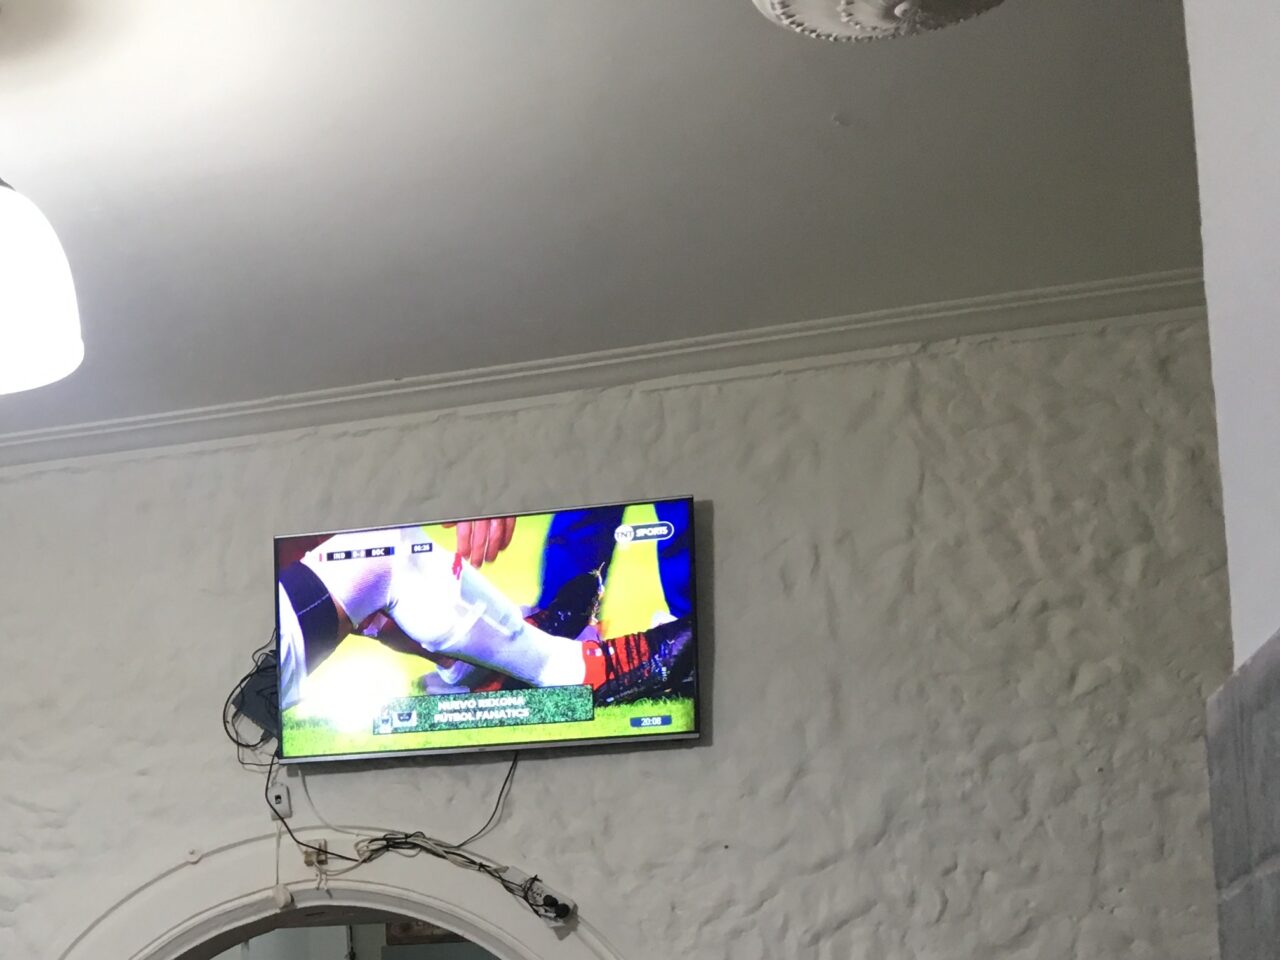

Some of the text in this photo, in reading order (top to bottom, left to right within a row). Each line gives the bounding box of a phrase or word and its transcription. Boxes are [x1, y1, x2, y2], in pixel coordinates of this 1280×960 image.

[617, 526, 668, 539] TNT SPORTS
[438, 700, 477, 711] NUEVO
[476, 708, 530, 720] FANATICS
